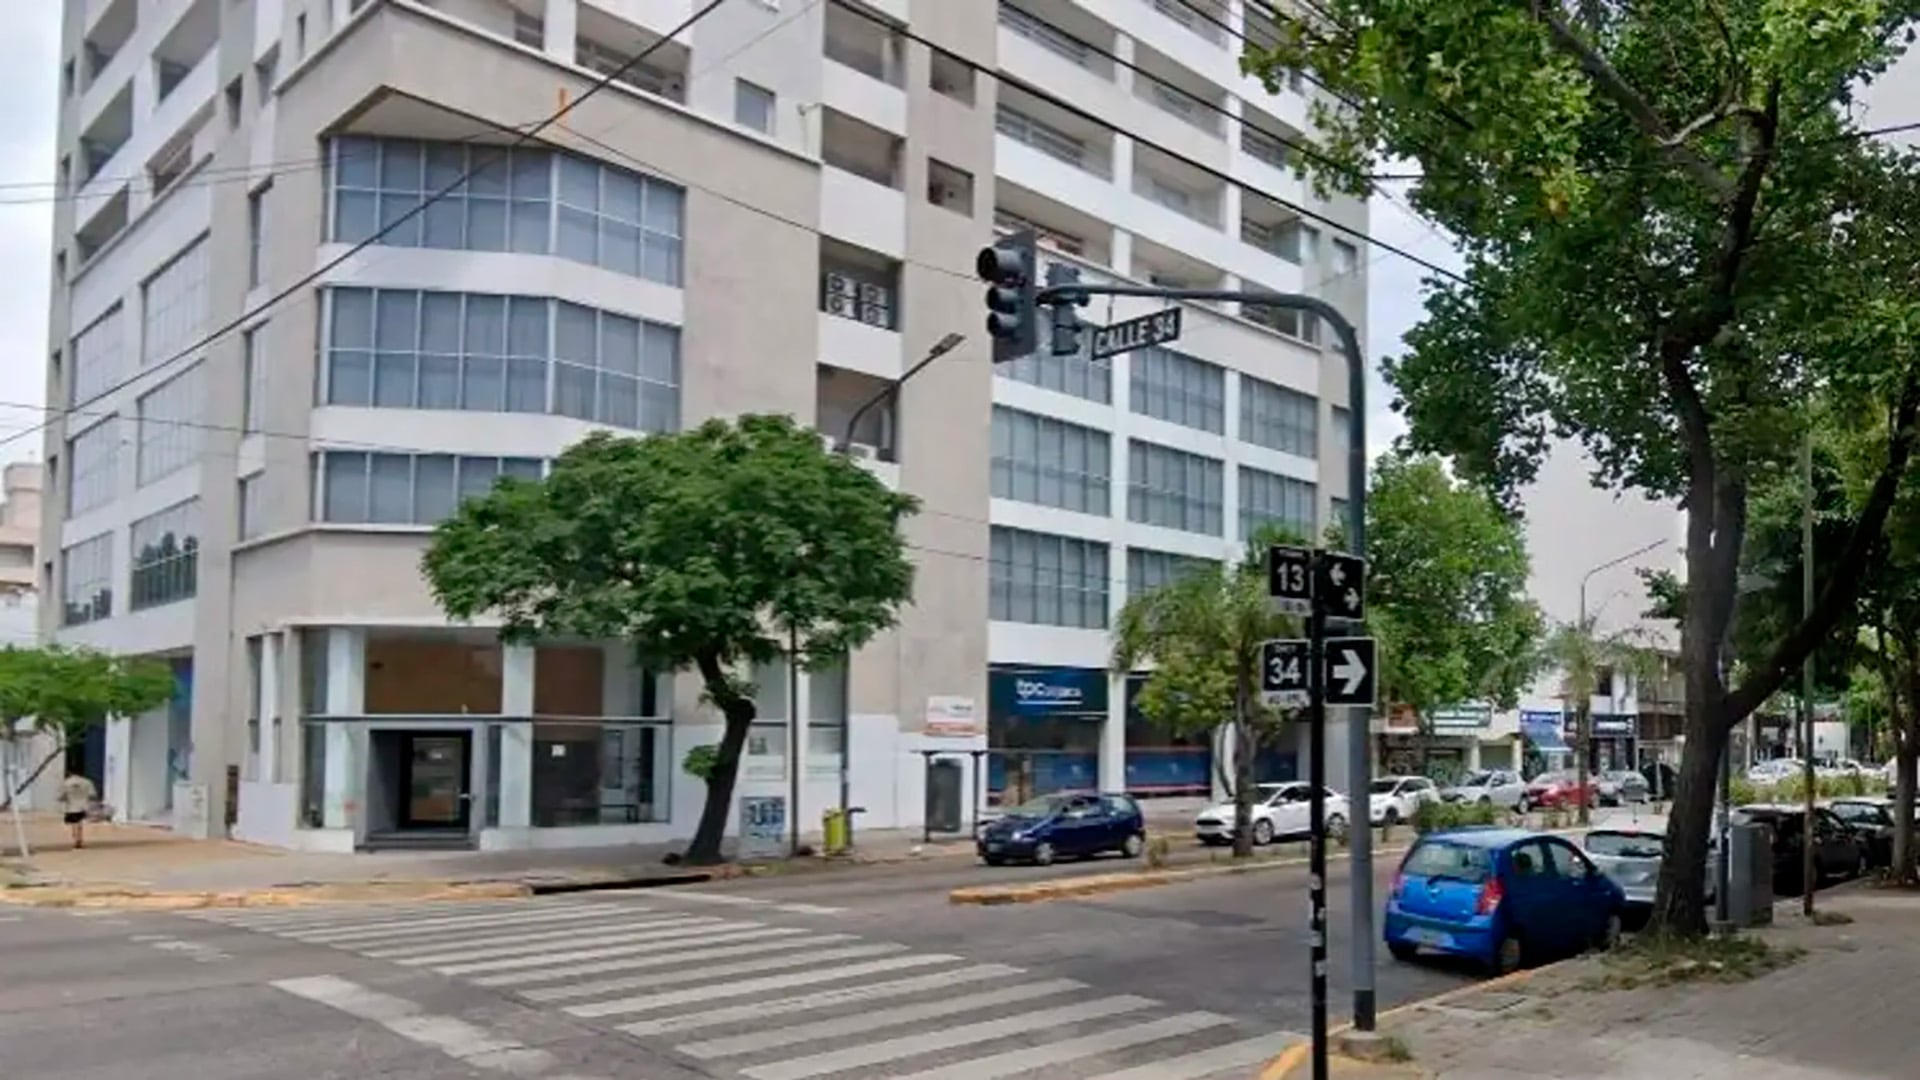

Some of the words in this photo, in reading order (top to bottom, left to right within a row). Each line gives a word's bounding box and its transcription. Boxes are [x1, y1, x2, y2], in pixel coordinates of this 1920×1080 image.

[1095, 320, 1148, 355] CALLE
[1276, 561, 1305, 592] 13
[1268, 656, 1301, 685] 34
